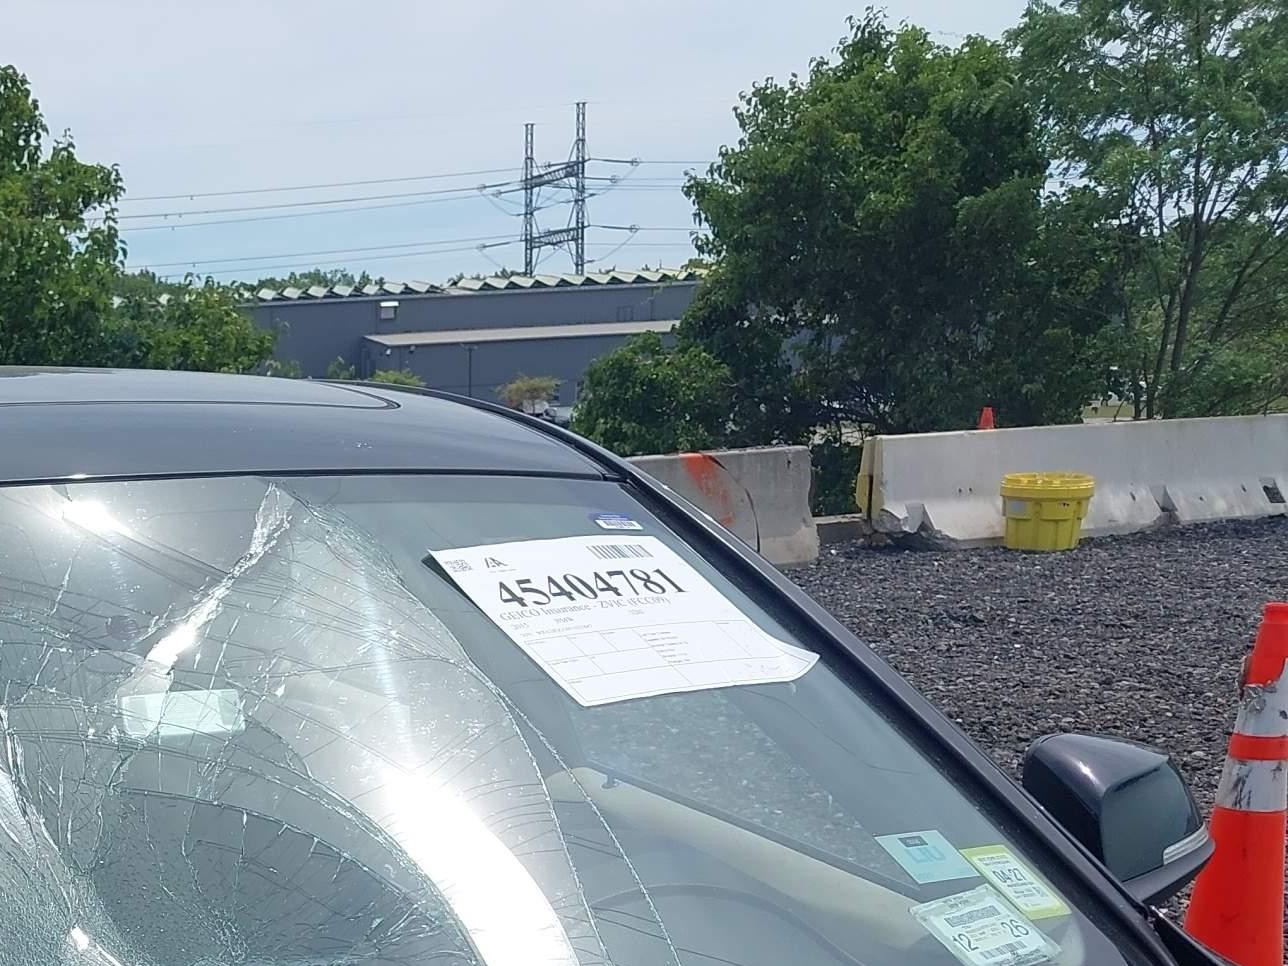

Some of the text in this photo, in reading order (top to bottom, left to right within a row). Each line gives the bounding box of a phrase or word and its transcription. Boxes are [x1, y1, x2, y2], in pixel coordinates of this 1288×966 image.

[499, 569, 687, 607] 45404781
[499, 608, 541, 622] GEICO
[540, 604, 591, 616] Insurance
[952, 933, 979, 952] 12
[1000, 919, 1029, 938] 26
